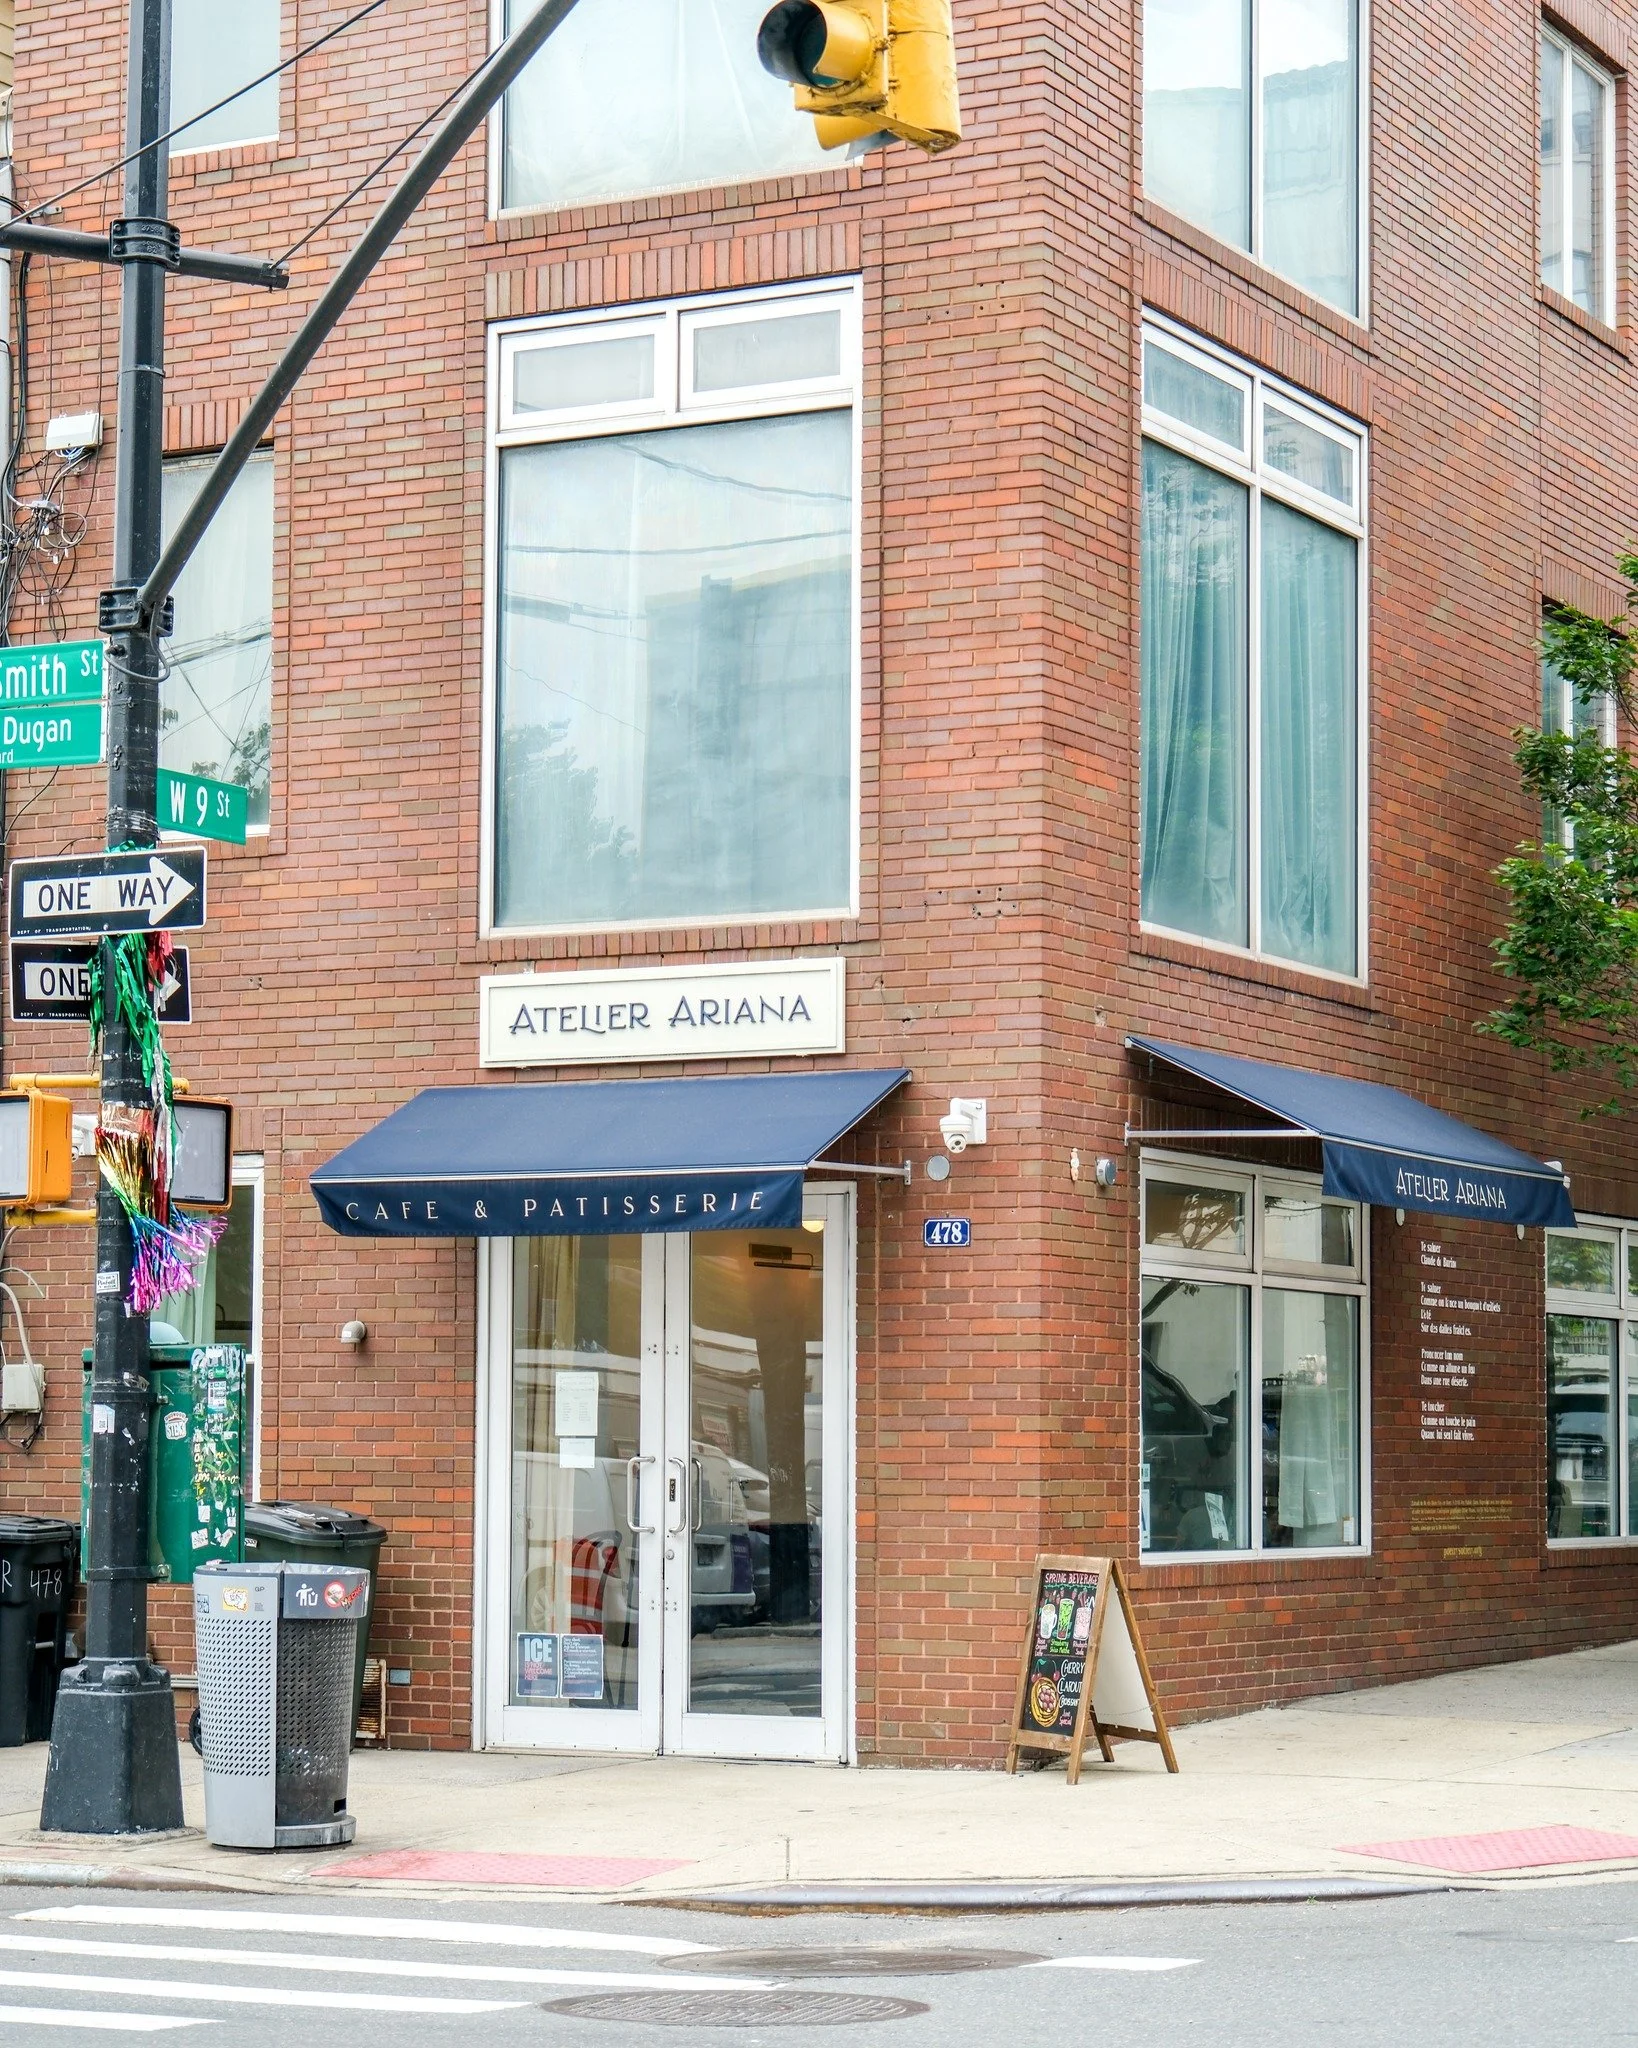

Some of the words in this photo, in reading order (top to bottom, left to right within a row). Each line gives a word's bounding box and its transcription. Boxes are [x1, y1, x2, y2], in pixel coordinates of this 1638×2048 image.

[0, 654, 67, 698] mith
[81, 650, 98, 676] St
[4, 717, 72, 752] Dugan
[170, 780, 186, 823] W
[197, 786, 208, 827] 9
[217, 790, 230, 818] St
[38, 882, 91, 912] ONE
[118, 876, 174, 907] WAY
[40, 967, 91, 996] ONE
[508, 1003, 651, 1035] ATELIER
[669, 994, 811, 1027] ARIANA
[346, 1201, 439, 1220] CAFE
[474, 1200, 488, 1219] &
[524, 1191, 764, 1218] PATISSERIE
[1396, 1167, 1450, 1202] ATELIER
[1455, 1178, 1507, 1209] ARIANA
[930, 1222, 962, 1244] 478
[2, 1560, 12, 1594] R
[30, 1568, 62, 1598] 478
[1045, 1573, 1067, 1584] SPRING
[525, 1638, 552, 1662] ICE
[1061, 1659, 1085, 1678] CHERRY
